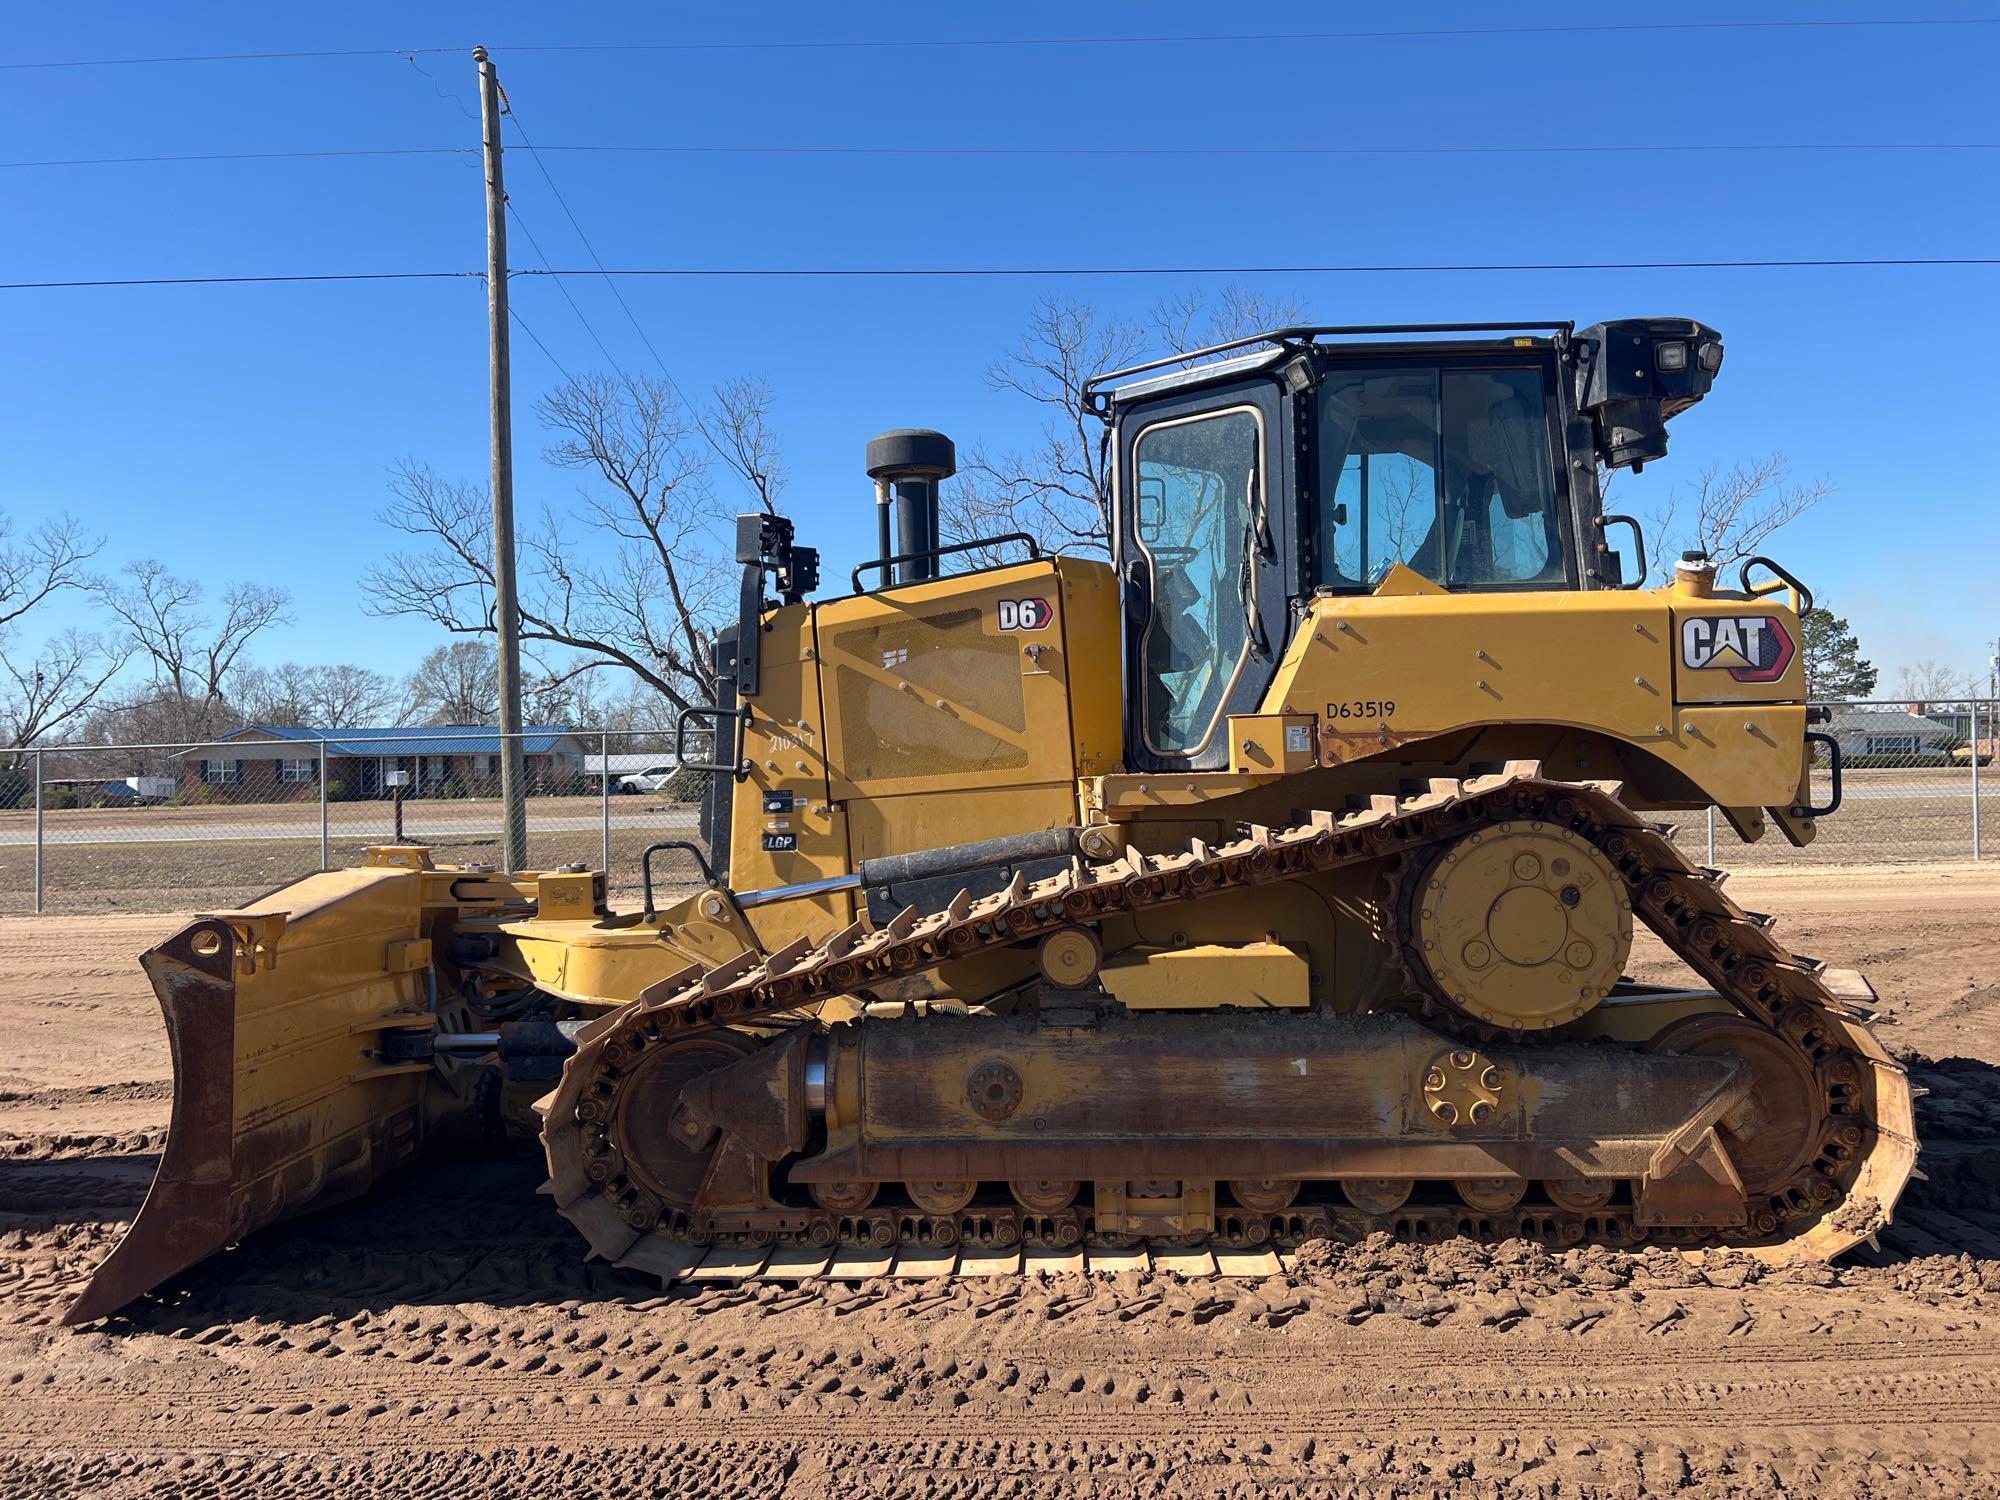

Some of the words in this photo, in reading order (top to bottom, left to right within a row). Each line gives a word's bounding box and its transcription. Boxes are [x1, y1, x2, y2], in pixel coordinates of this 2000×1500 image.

[999, 600, 1036, 629] D6
[1683, 618, 1766, 668] CAT
[1327, 701, 1396, 719] D63519
[767, 836, 793, 849] LGP
